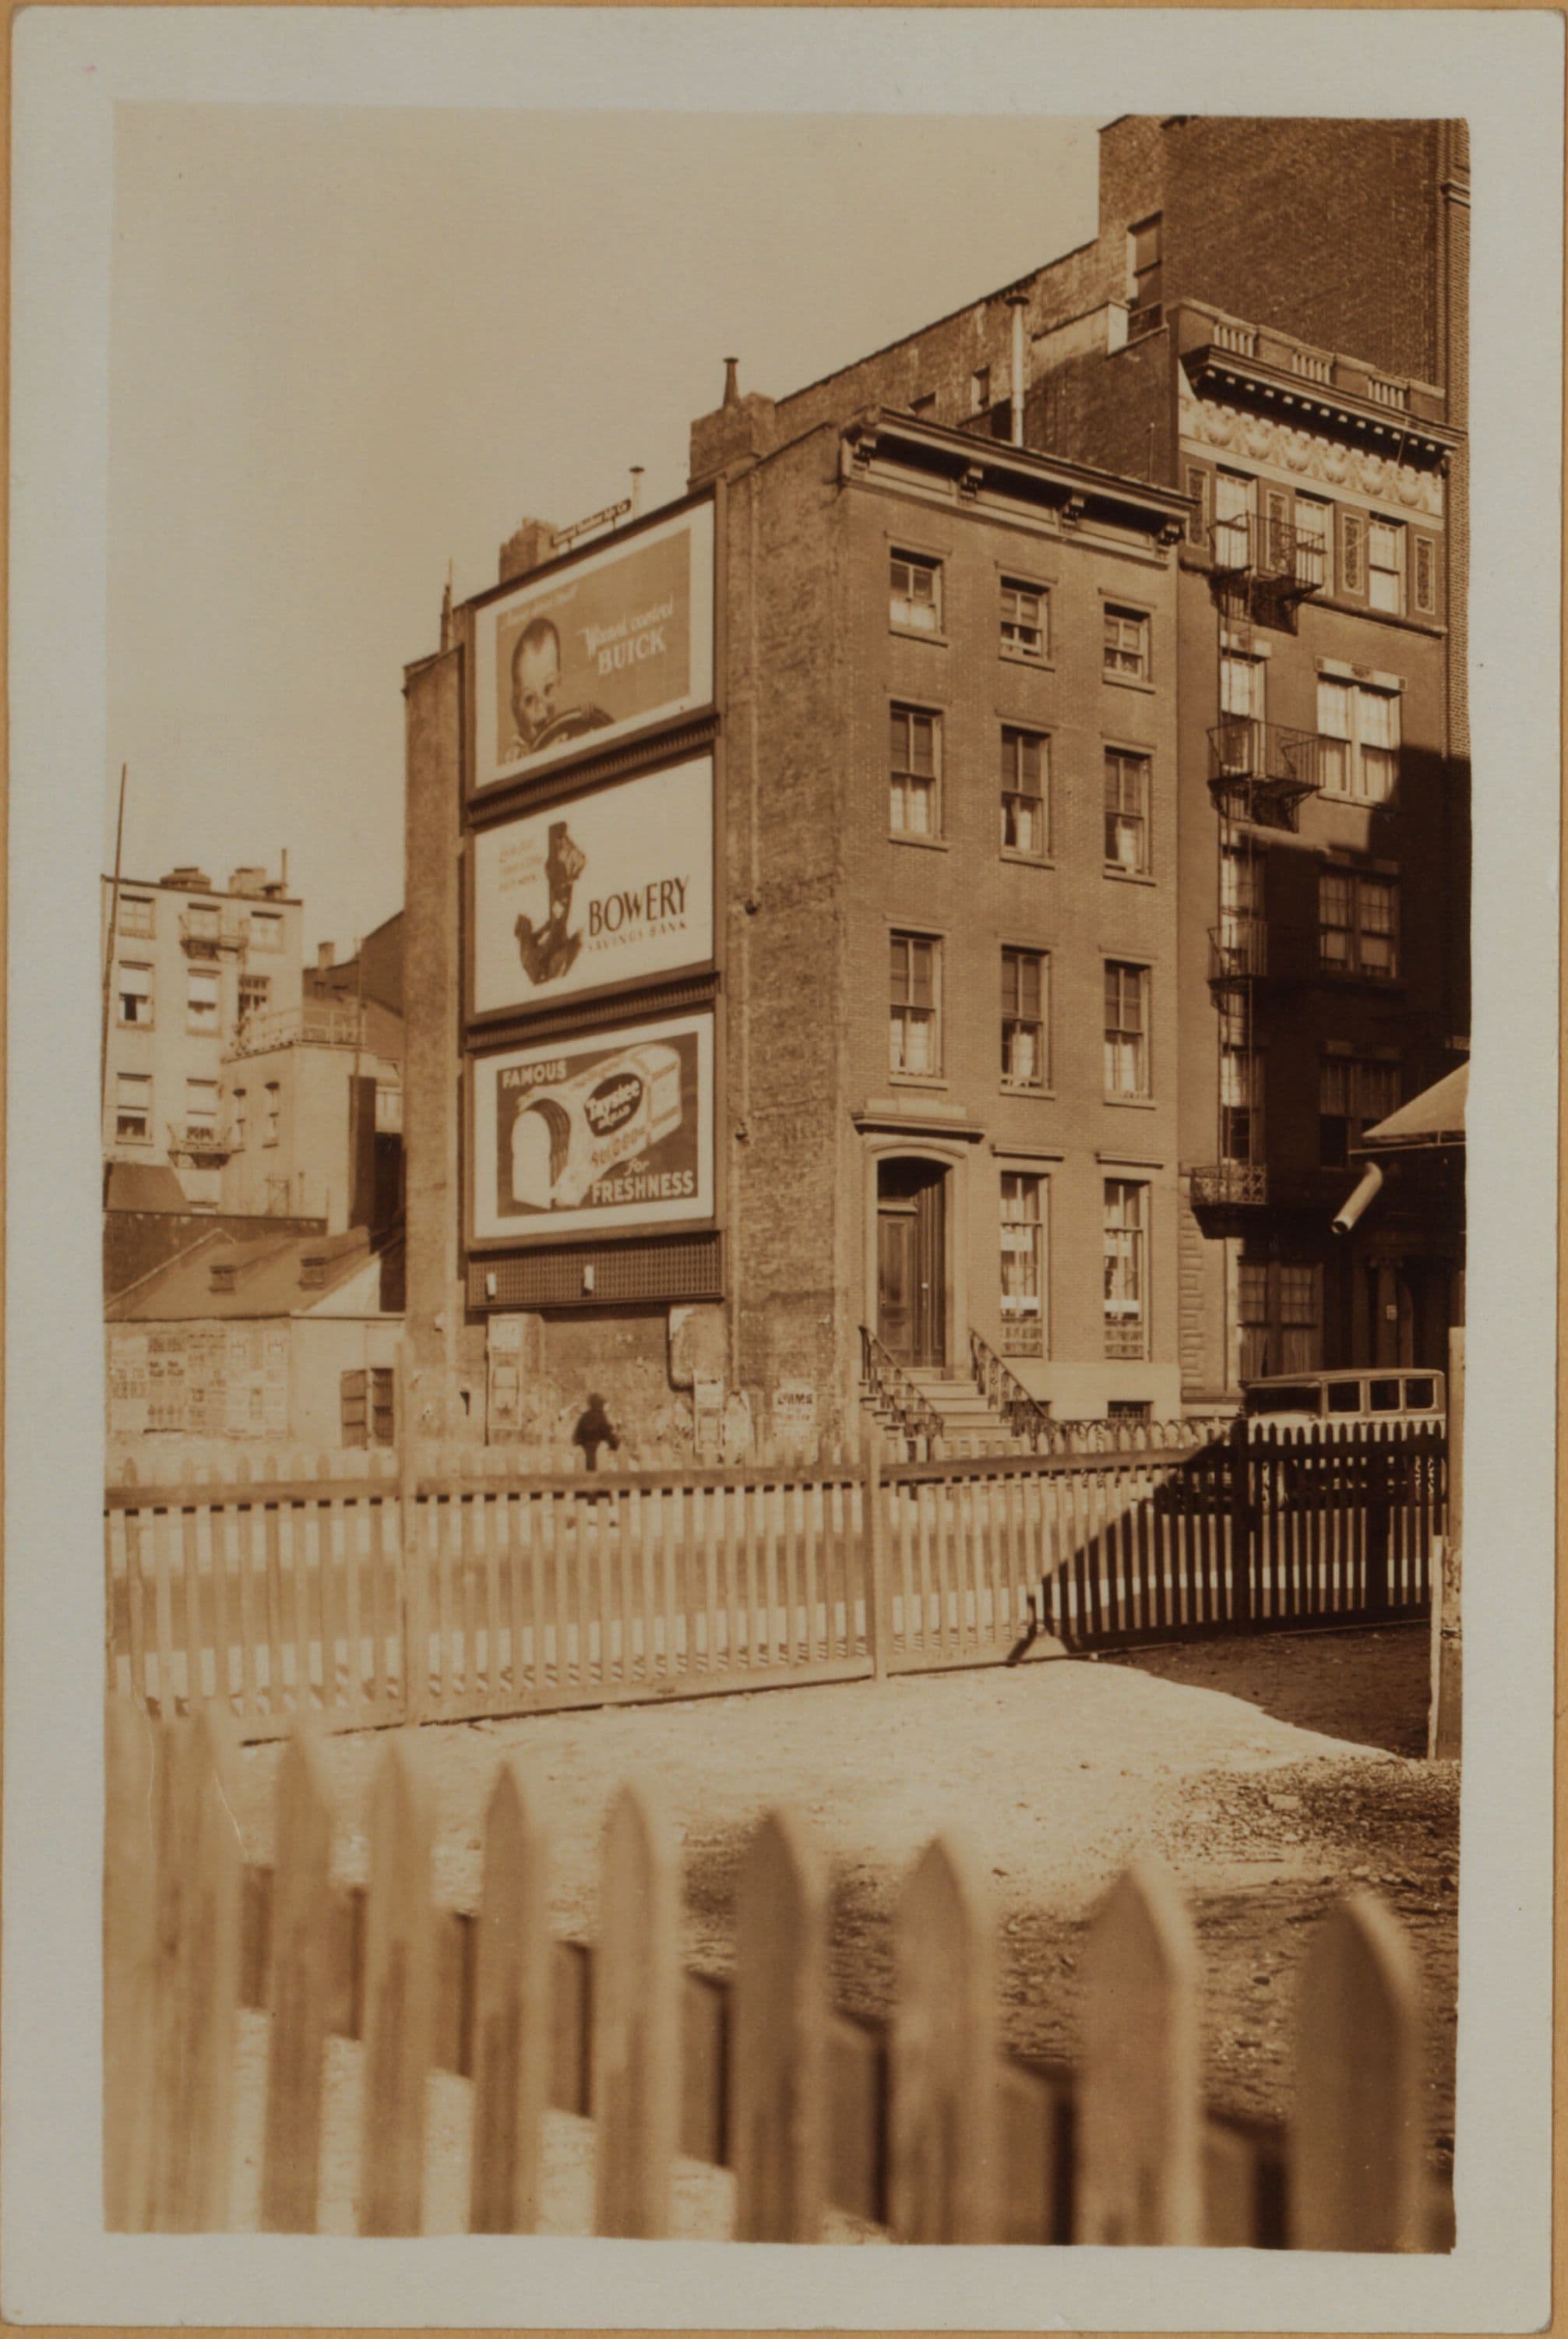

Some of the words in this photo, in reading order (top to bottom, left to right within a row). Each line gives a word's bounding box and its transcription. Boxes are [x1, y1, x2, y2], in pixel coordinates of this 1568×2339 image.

[597, 625, 667, 676] BUICK
[588, 873, 690, 937] BOWERY
[502, 1060, 567, 1088] FAMOUS
[623, 1158, 650, 1177] for
[592, 1170, 694, 1205] FRESHNESS
